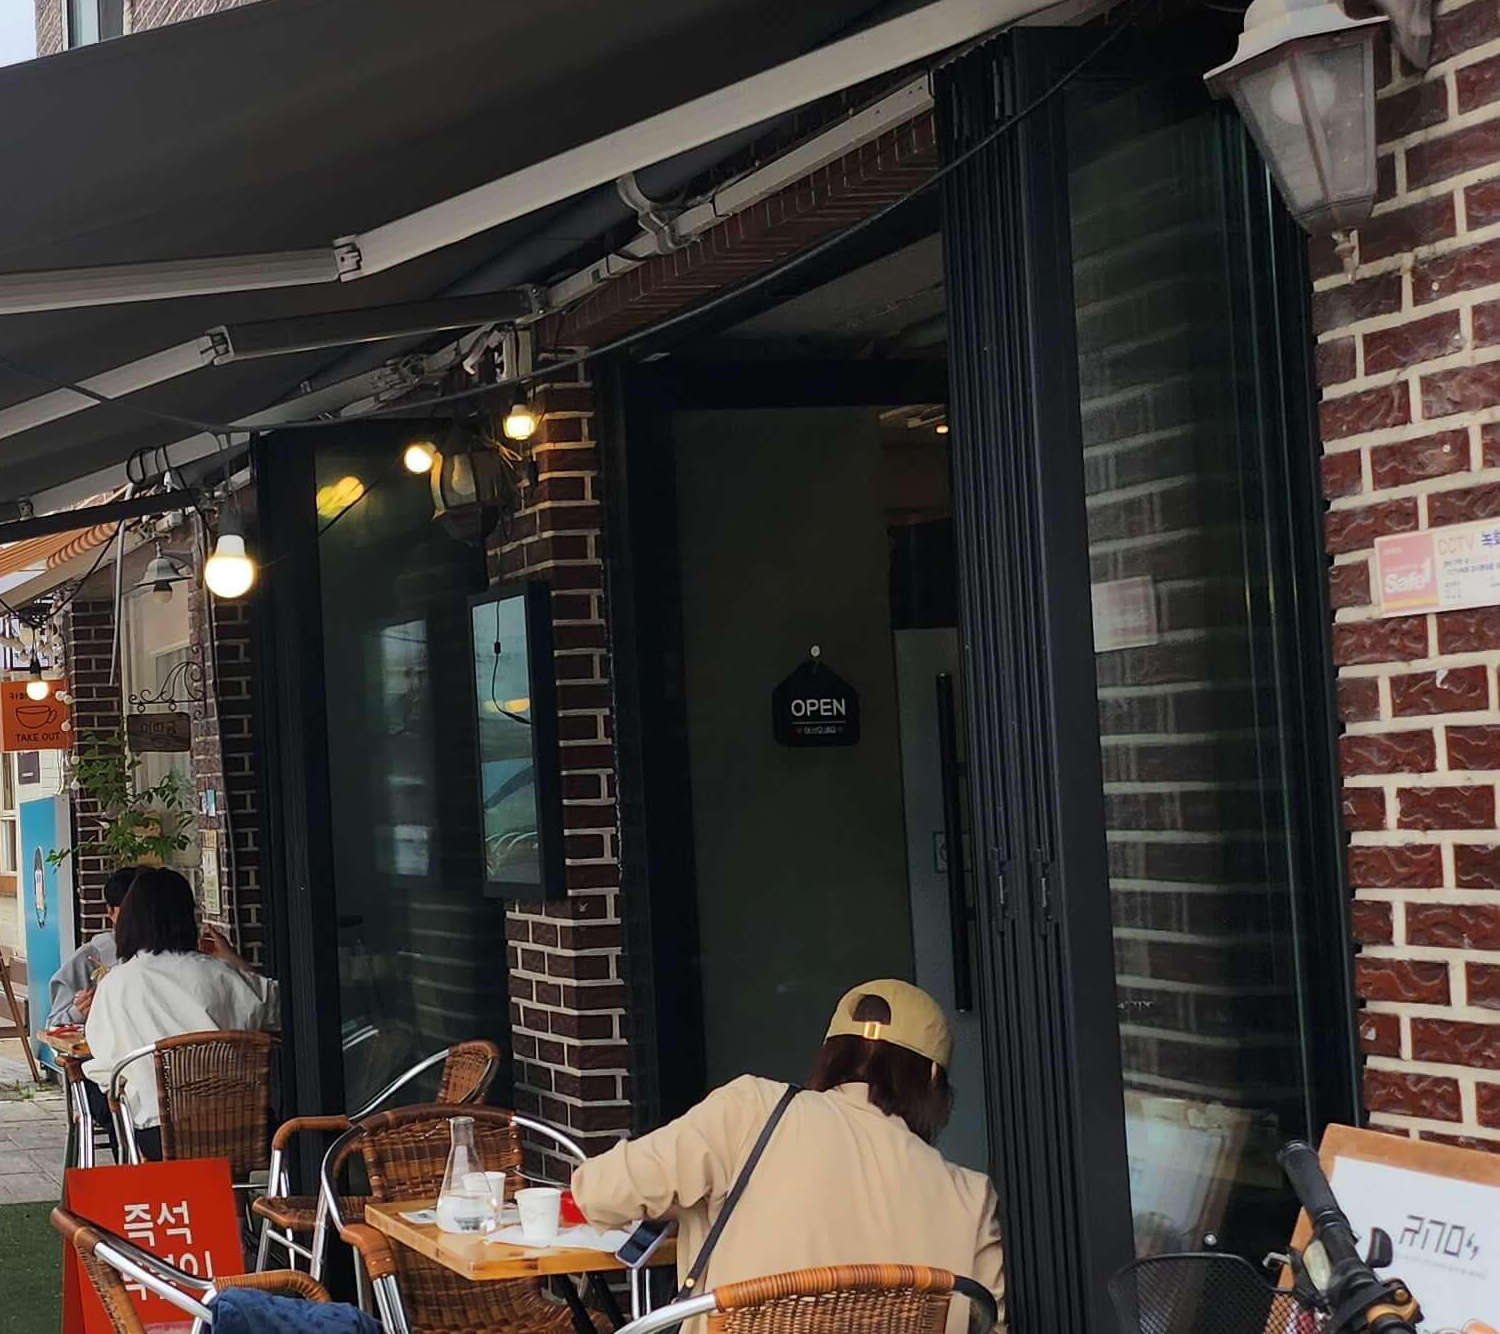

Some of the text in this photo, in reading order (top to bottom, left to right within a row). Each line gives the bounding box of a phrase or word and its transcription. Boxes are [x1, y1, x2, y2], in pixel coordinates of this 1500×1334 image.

[791, 698, 846, 716] OPEN
[15, 731, 61, 742] TAKE OUT
[123, 1200, 193, 1247] 즉석
